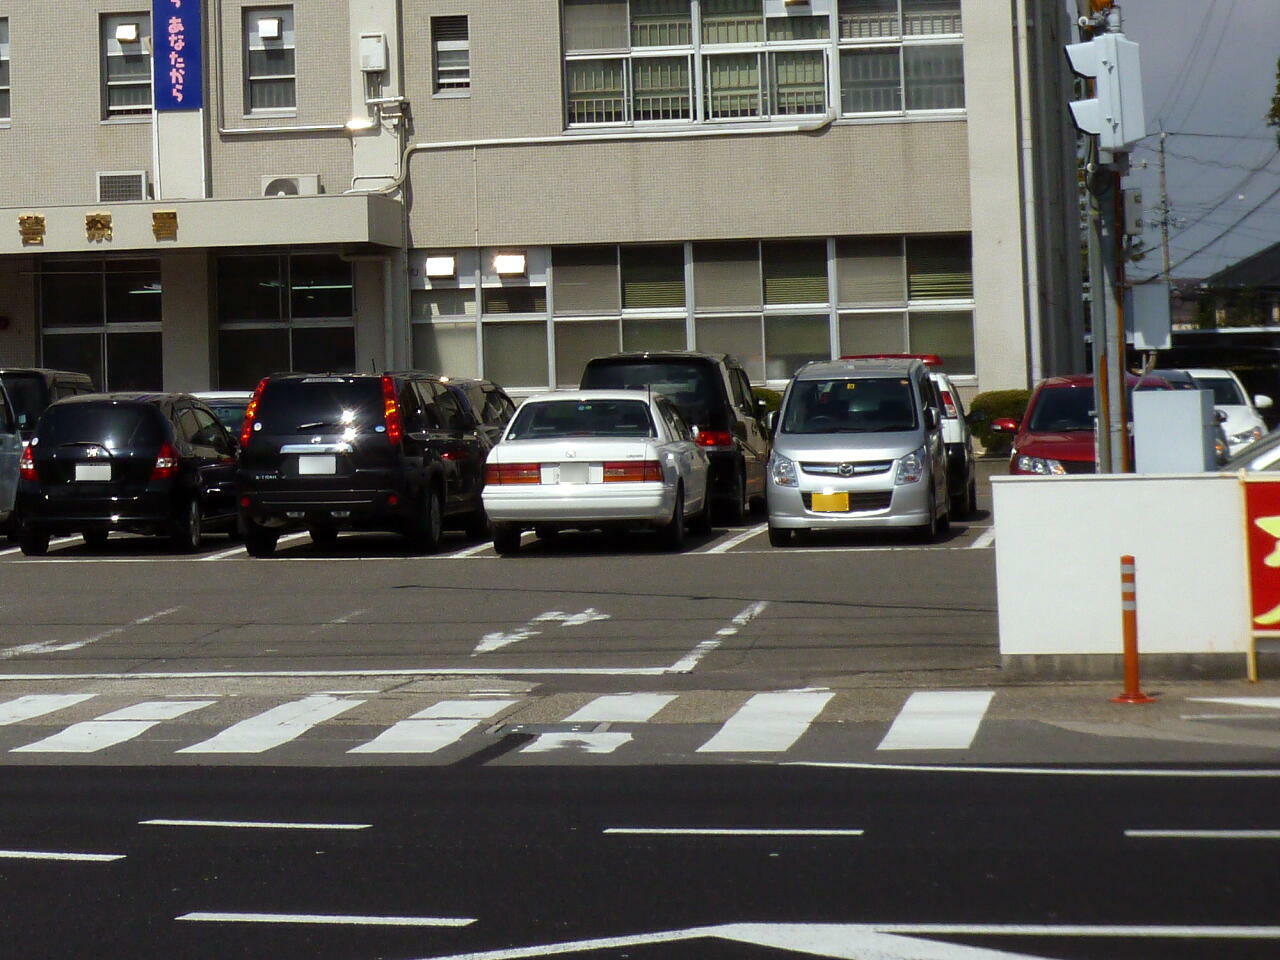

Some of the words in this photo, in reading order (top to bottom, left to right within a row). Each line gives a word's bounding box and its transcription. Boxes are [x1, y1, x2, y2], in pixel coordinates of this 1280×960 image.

[168, 16, 186, 103] あなたから
